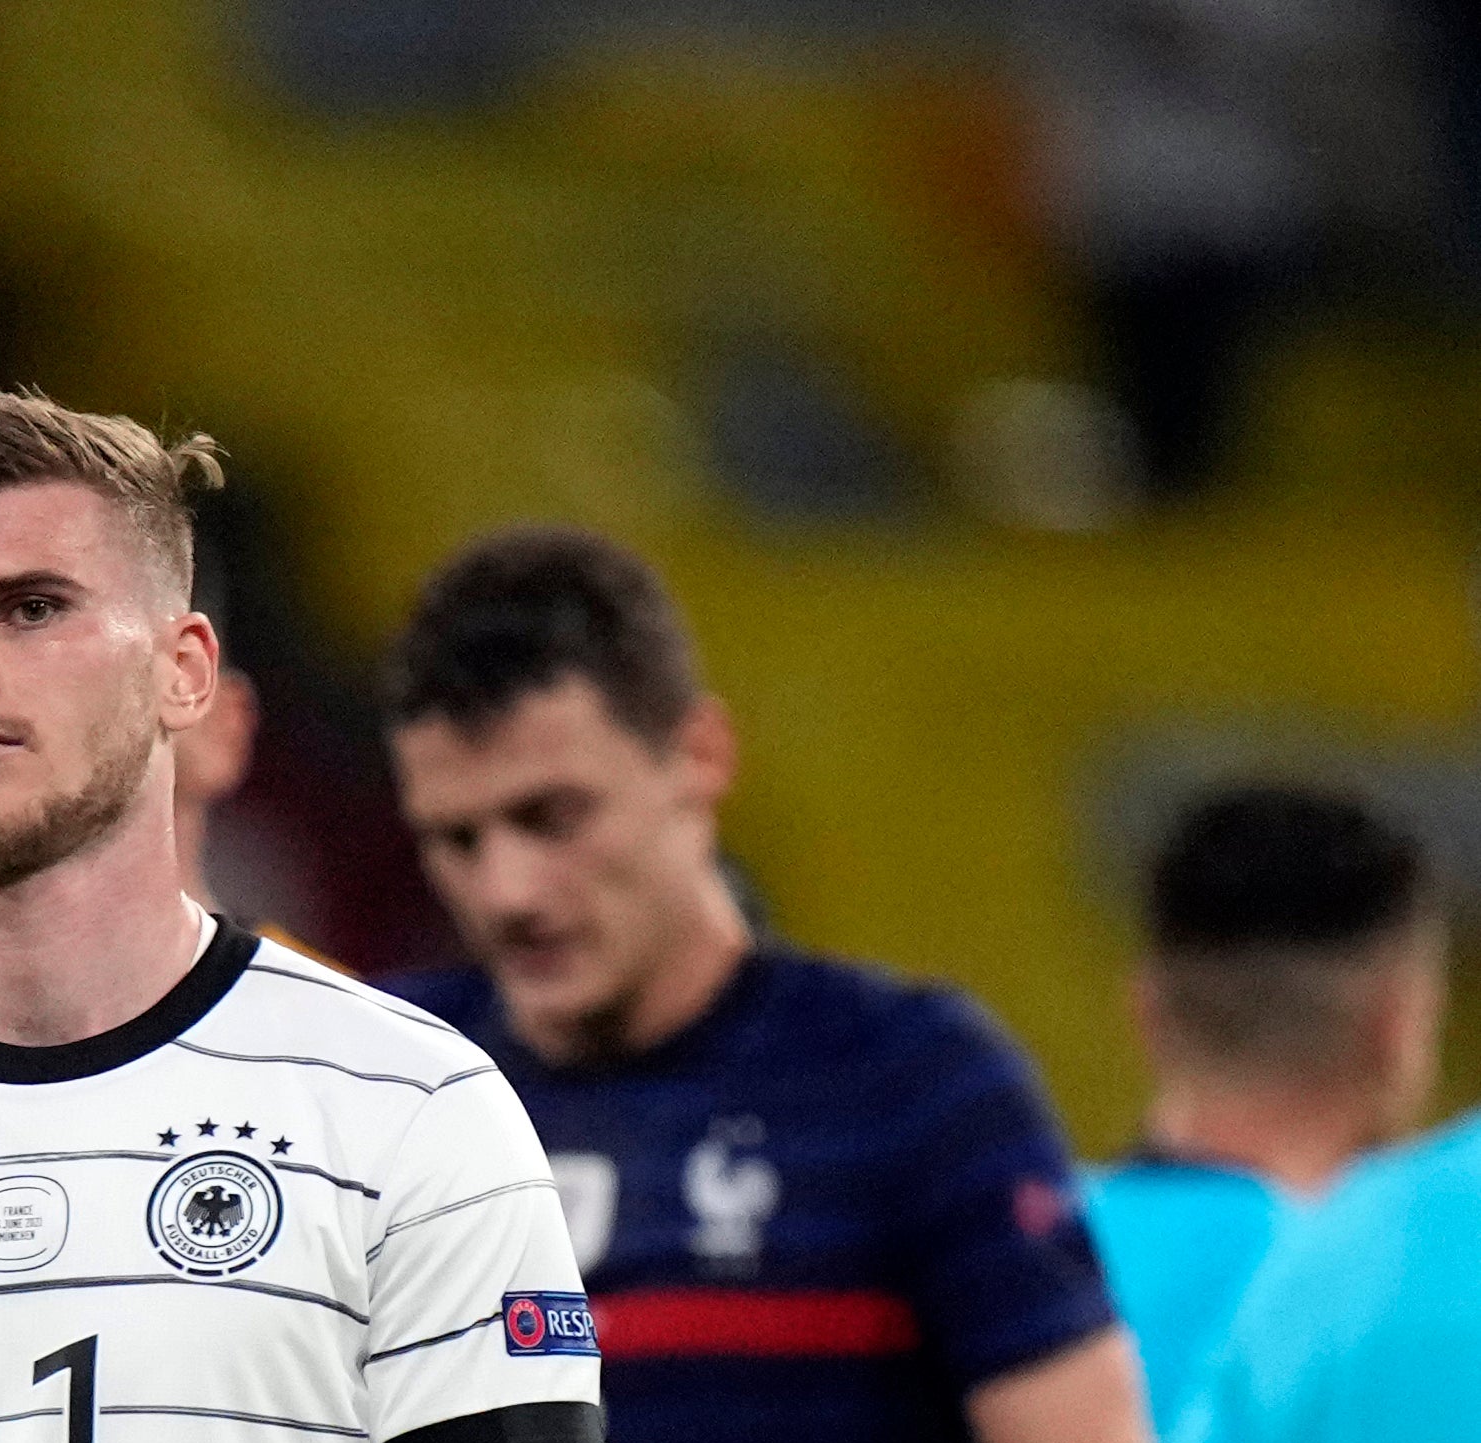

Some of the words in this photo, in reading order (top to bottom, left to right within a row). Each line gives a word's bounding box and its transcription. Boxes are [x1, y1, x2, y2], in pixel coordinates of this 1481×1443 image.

[181, 1166, 258, 1190] DEUTSCHER
[166, 1223, 259, 1260] FUSSBALL-BUND
[546, 1309, 595, 1339] RESP
